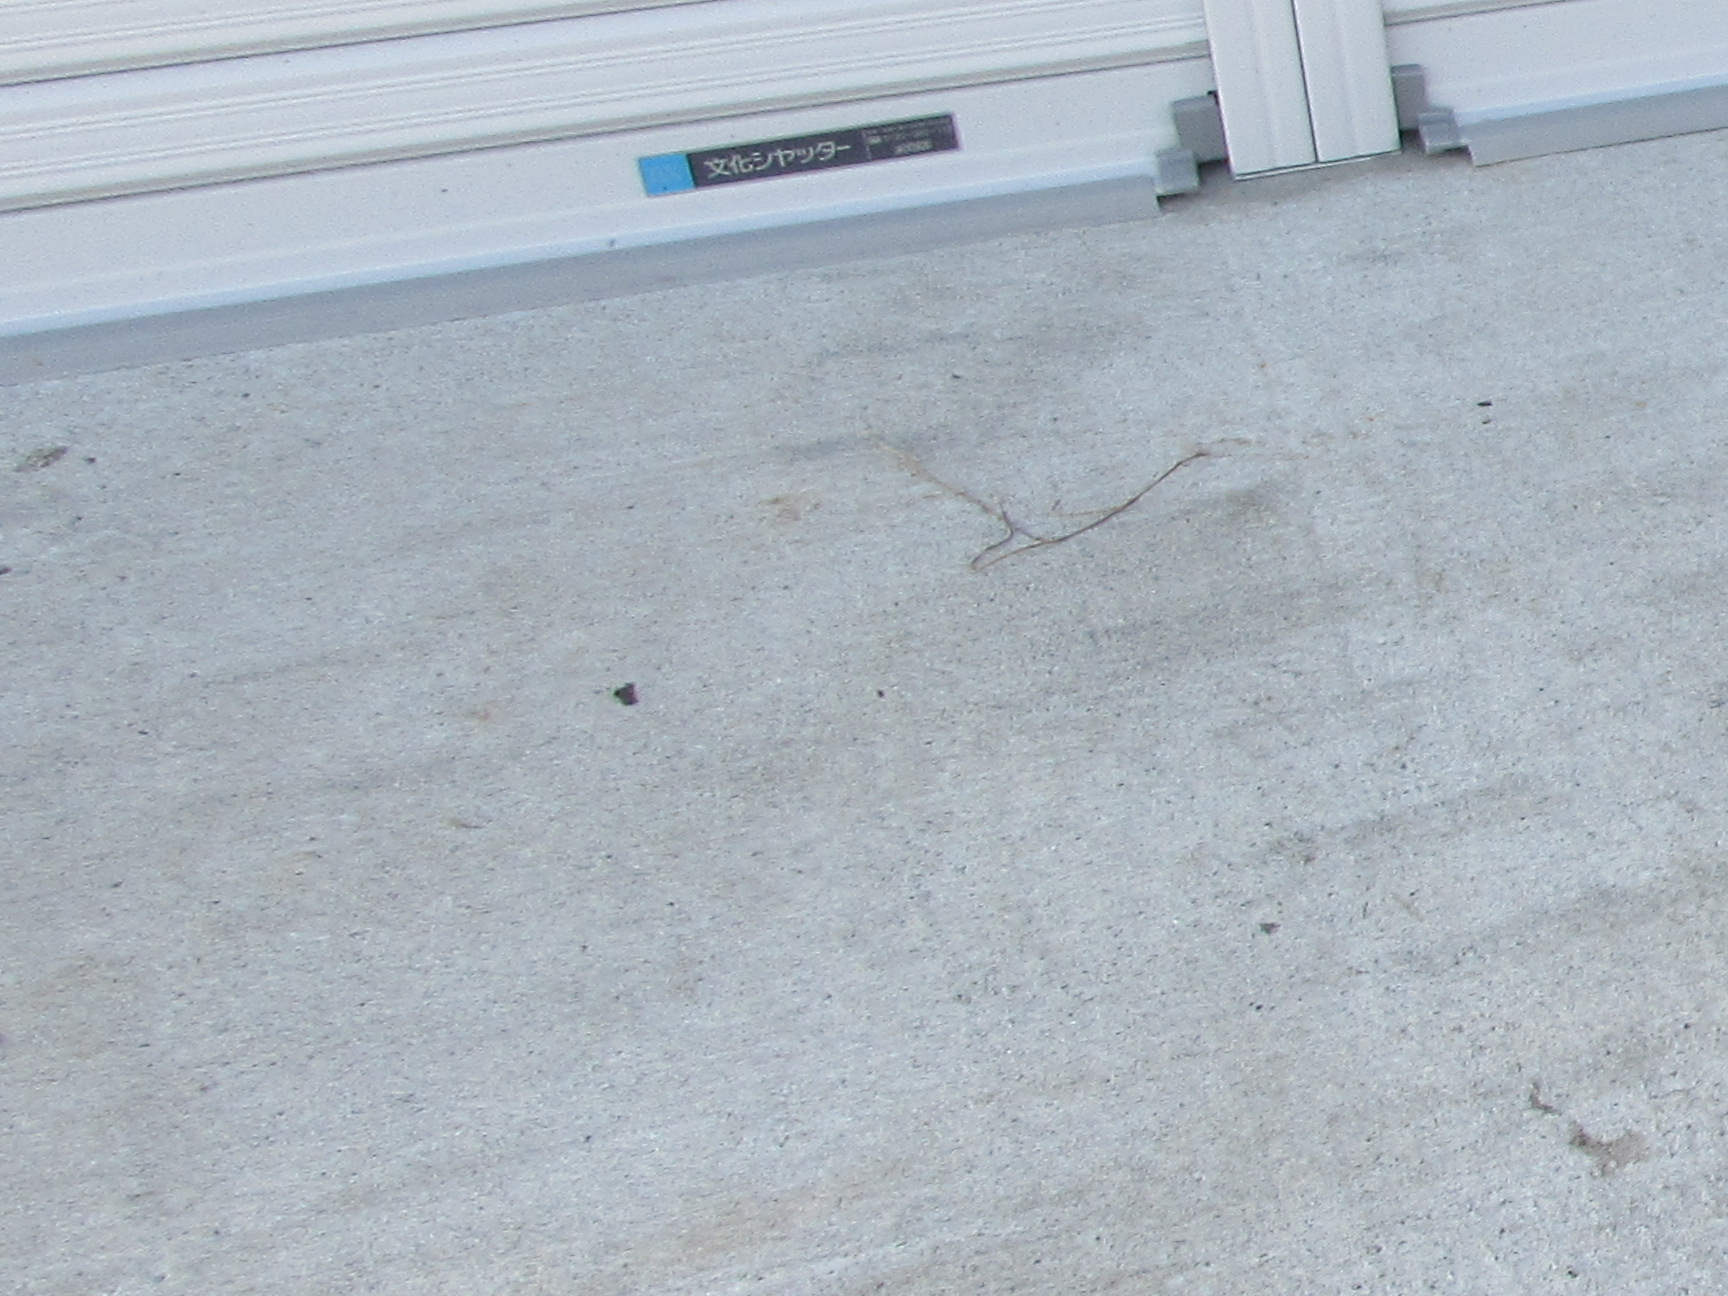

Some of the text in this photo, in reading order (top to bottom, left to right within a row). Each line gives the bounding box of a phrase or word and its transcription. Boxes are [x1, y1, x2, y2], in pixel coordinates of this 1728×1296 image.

[704, 142, 851, 179] 文化シャッター
